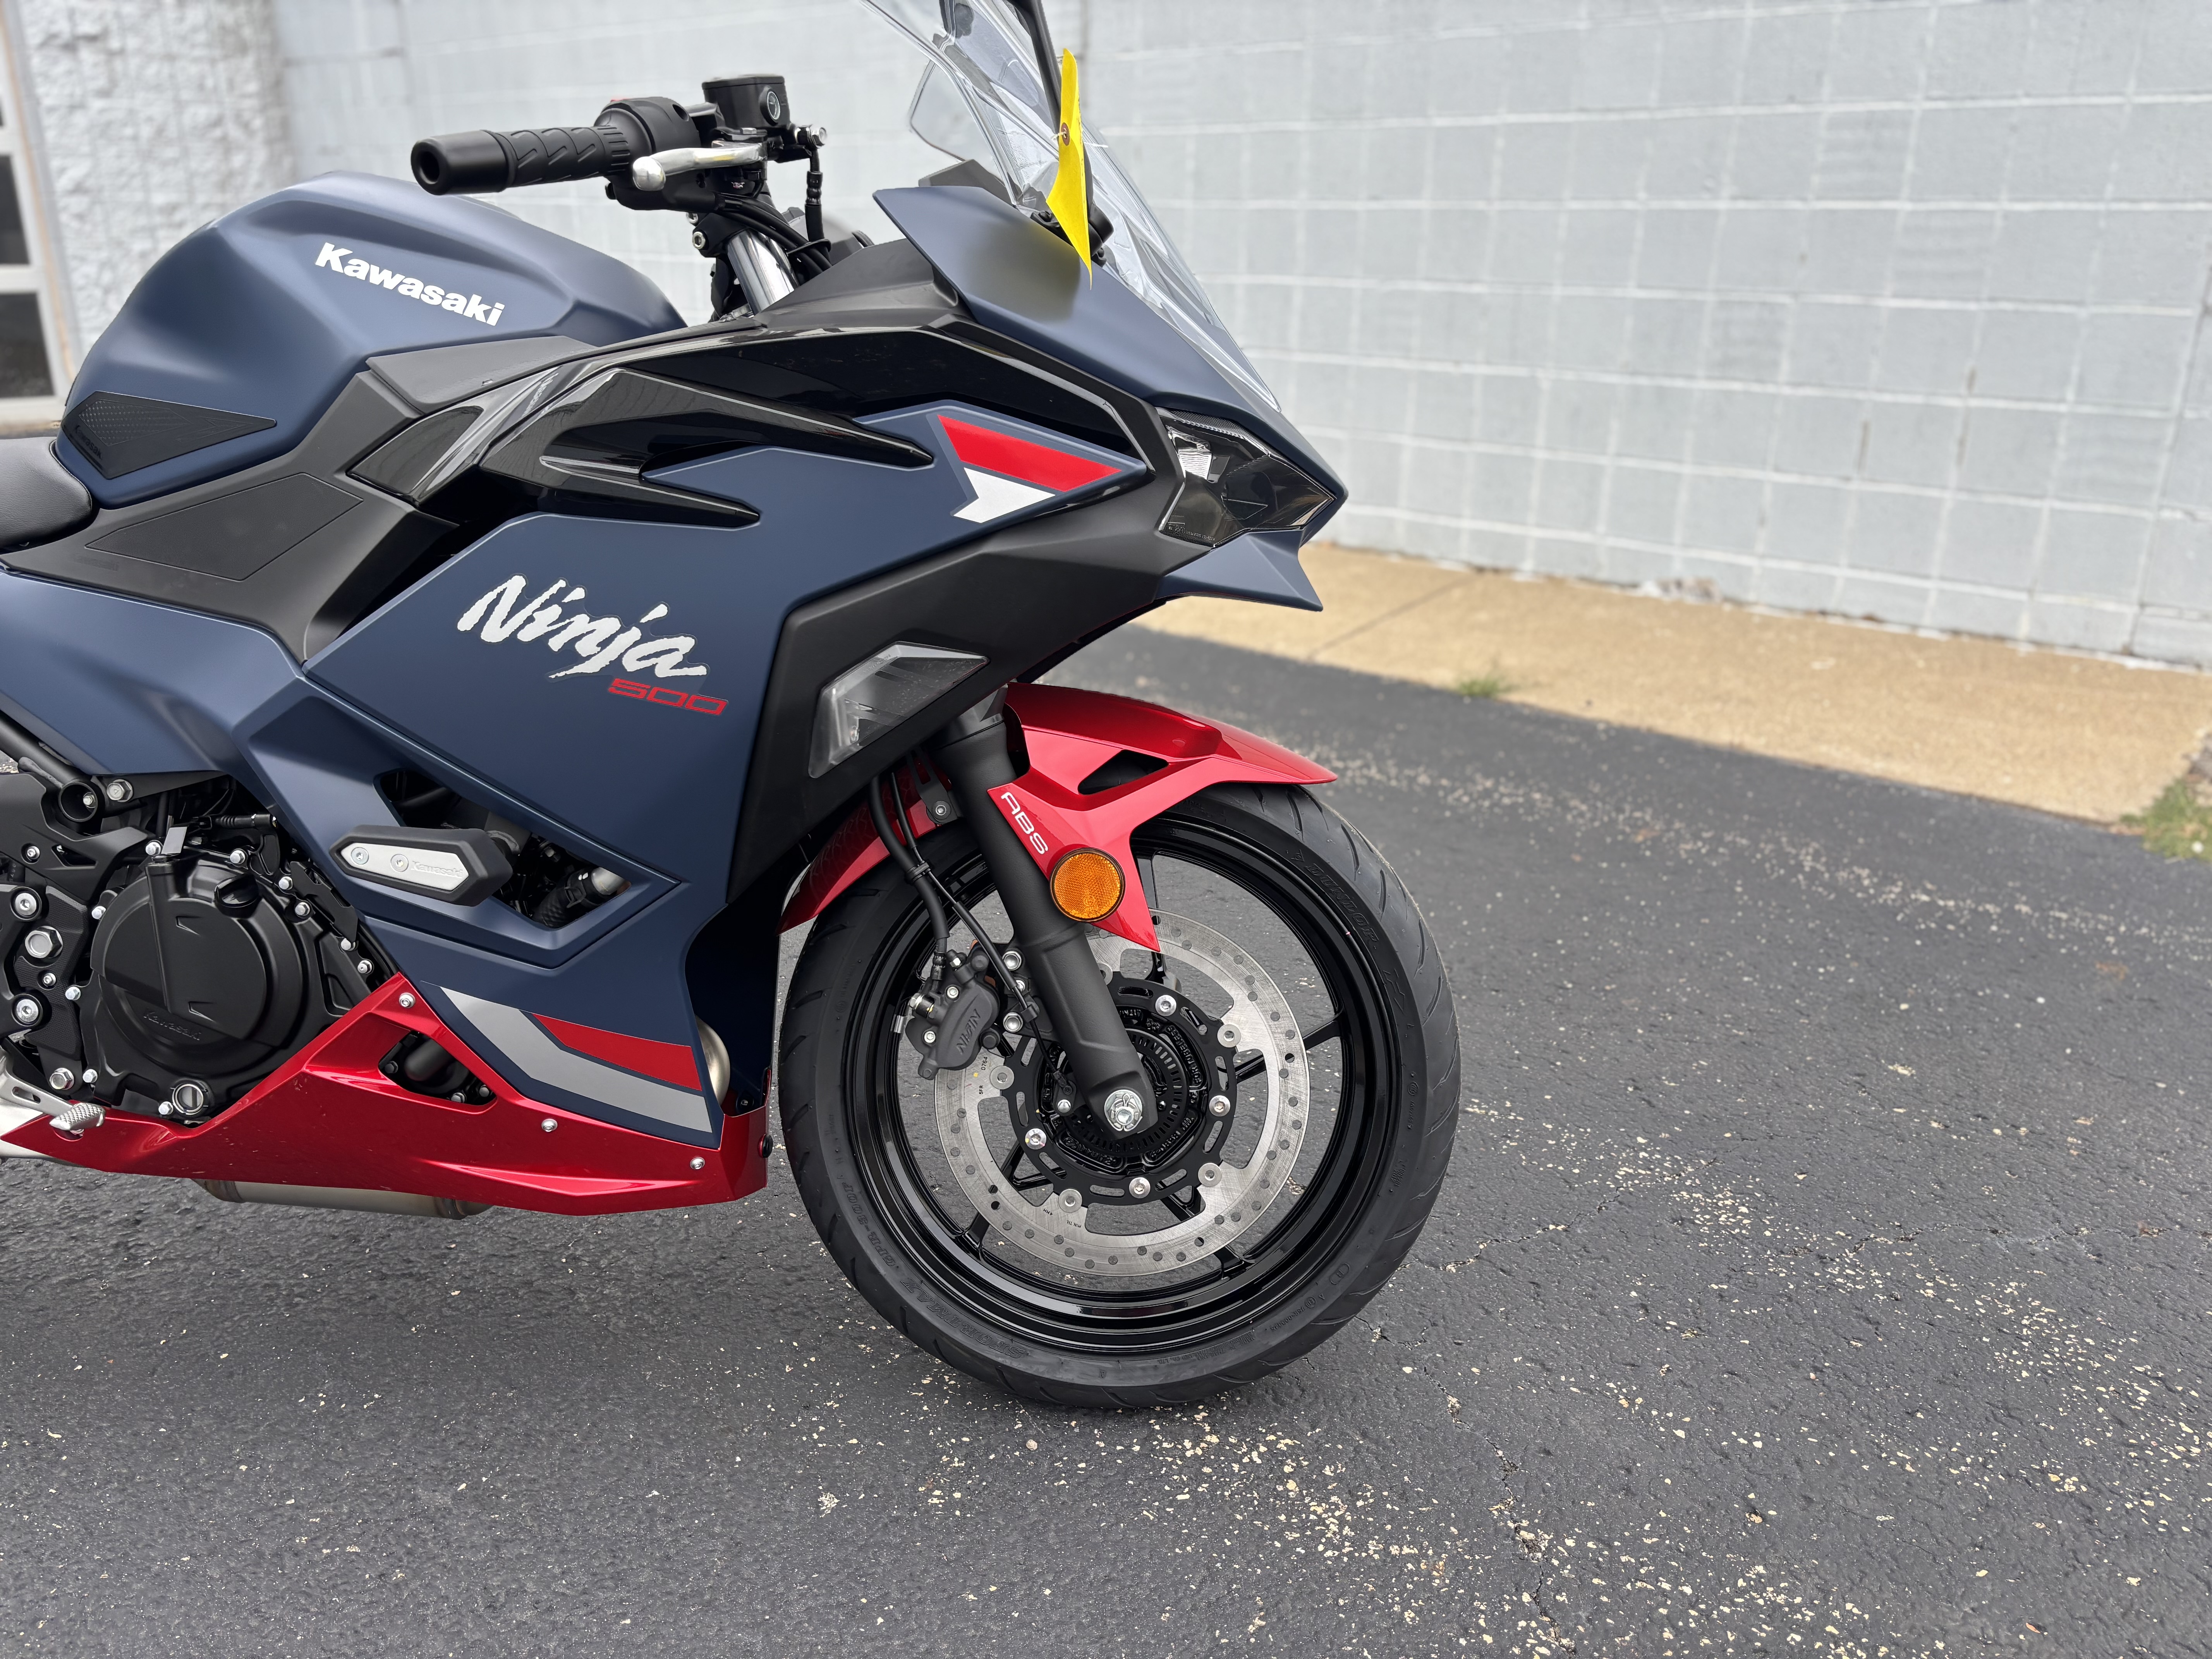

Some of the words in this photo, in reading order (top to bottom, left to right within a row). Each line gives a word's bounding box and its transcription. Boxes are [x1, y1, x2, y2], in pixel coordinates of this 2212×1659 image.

[315, 242, 505, 327] Kawasaki
[457, 575, 707, 678] Ninja
[608, 678, 729, 715] 500
[1001, 792, 1048, 855] ABS
[411, 860, 463, 879] Kawasaki
[143, 1010, 202, 1041] Kawasaki
